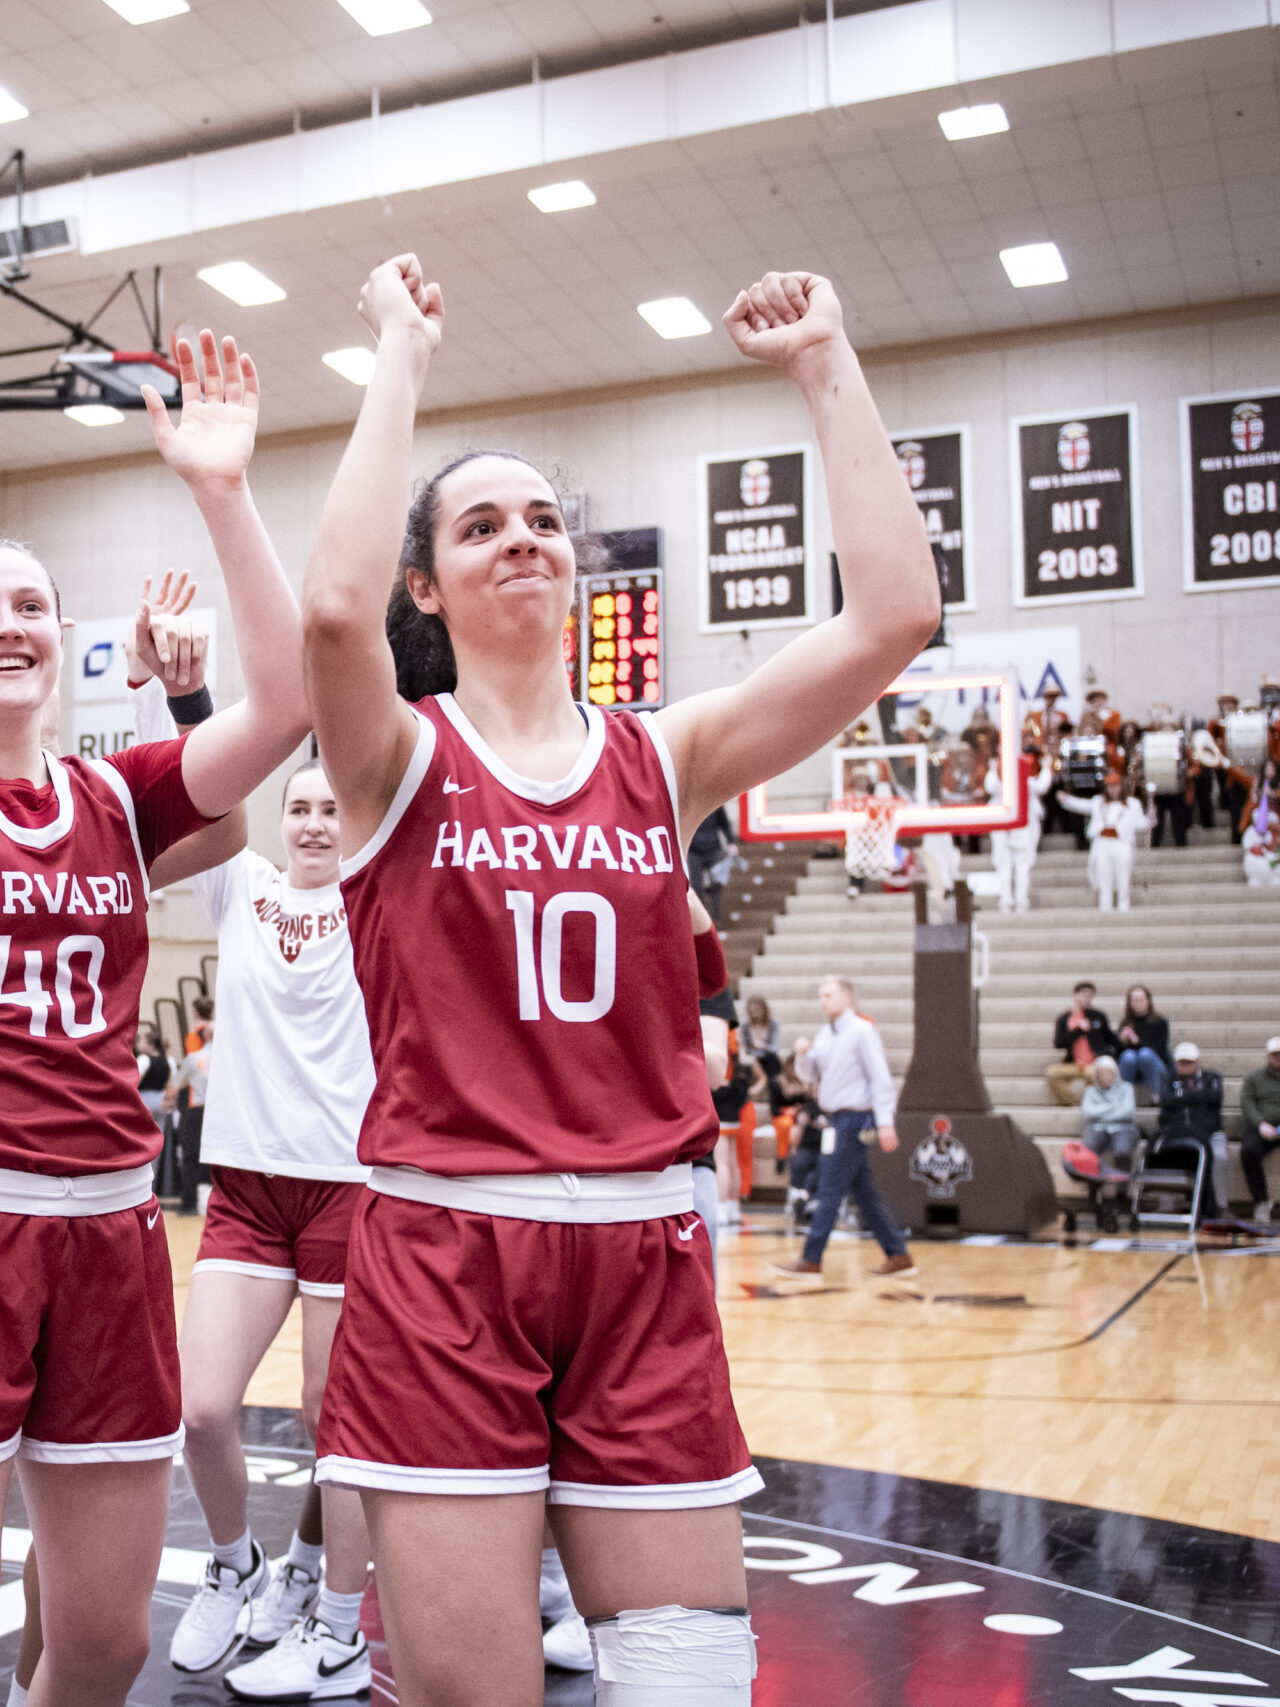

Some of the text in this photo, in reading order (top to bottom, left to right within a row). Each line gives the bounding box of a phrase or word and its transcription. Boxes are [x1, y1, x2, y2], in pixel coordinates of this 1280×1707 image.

[1052, 498, 1101, 533] NIT
[1223, 480, 1278, 516] CBI
[725, 525, 786, 553] NCAA
[1038, 544, 1118, 582] 2003
[723, 575, 791, 610] 1939
[431, 820, 673, 875] HARVARD
[505, 889, 616, 1022] 10
